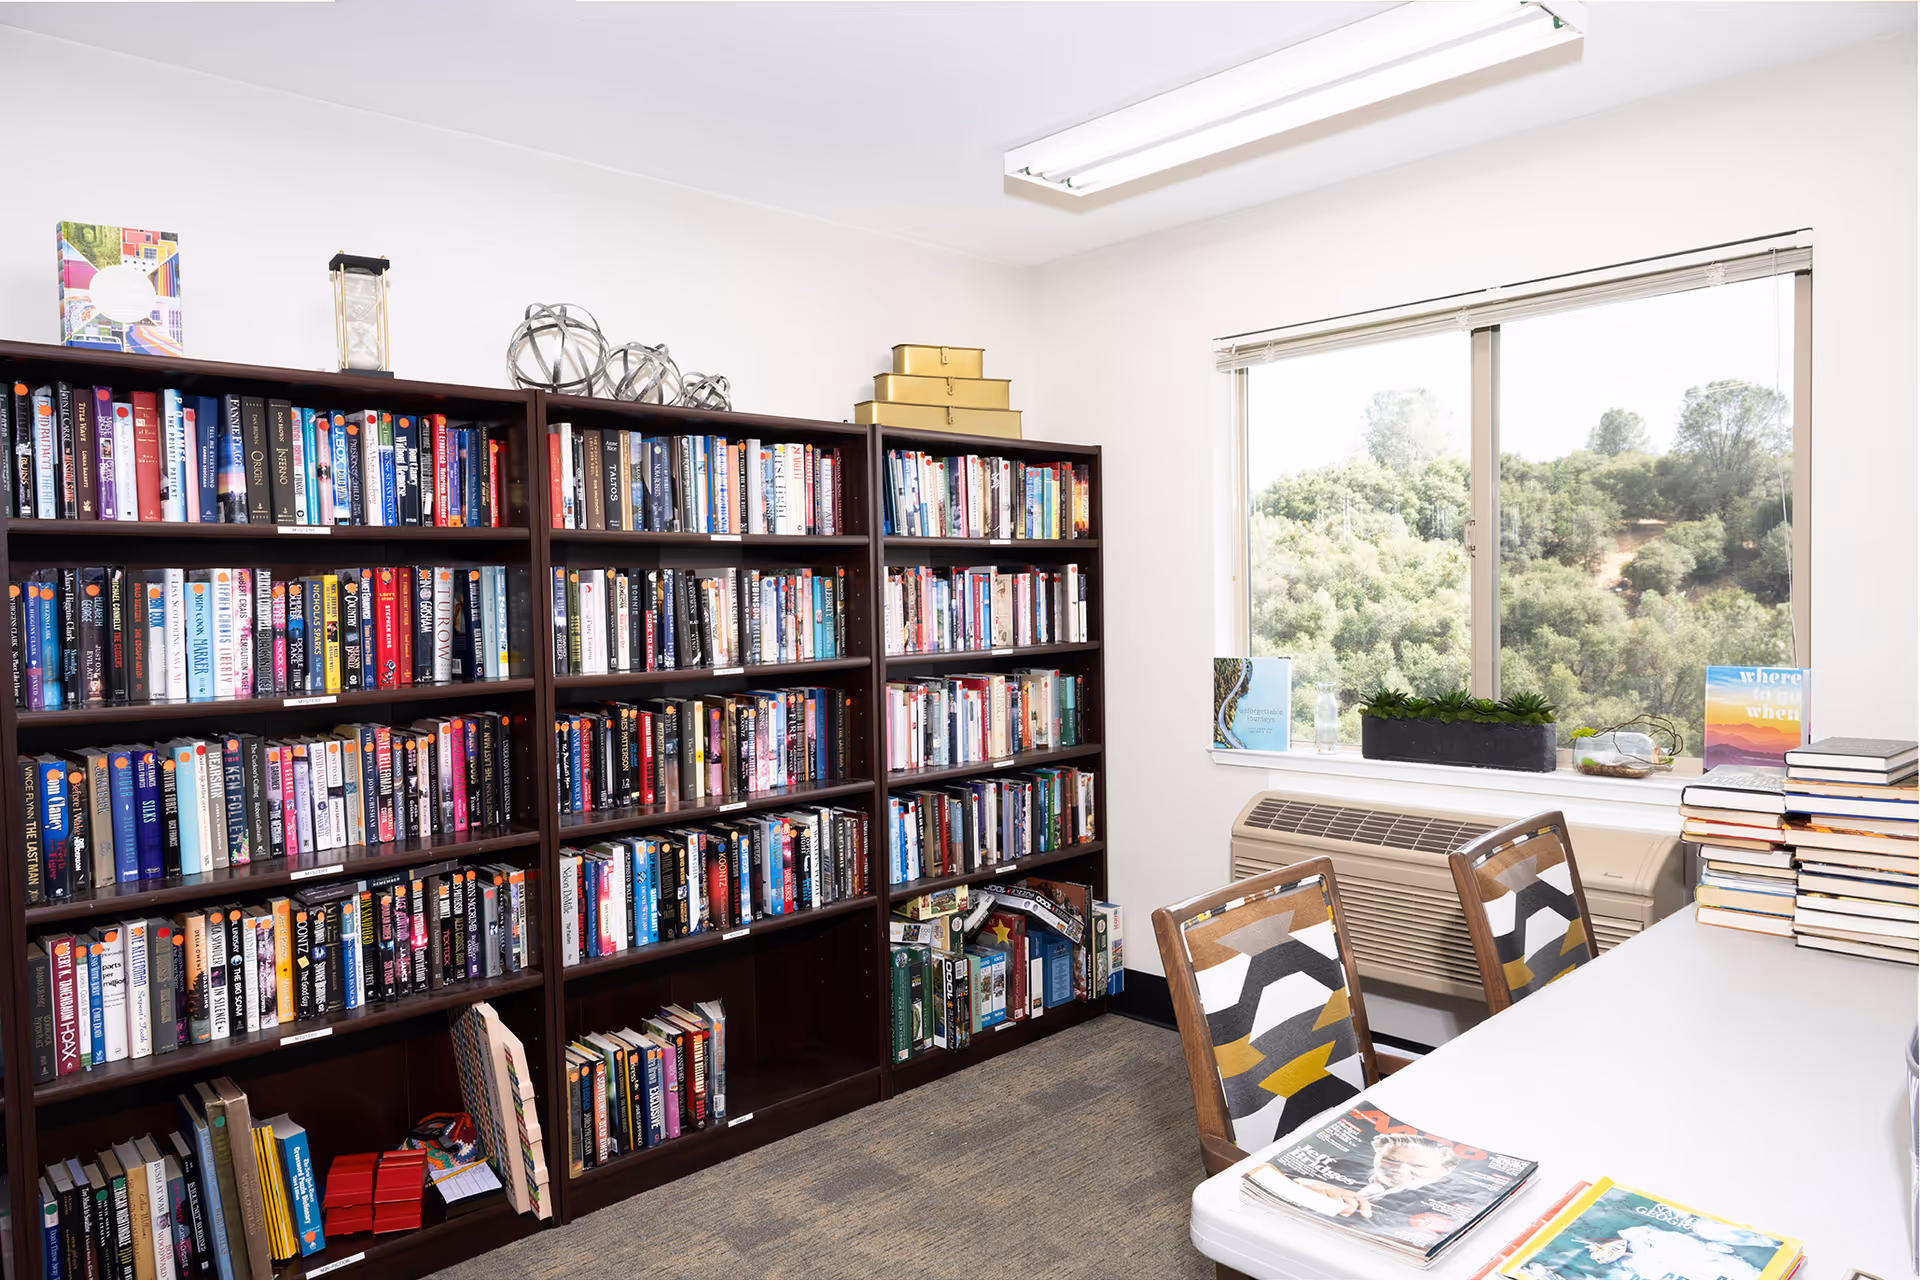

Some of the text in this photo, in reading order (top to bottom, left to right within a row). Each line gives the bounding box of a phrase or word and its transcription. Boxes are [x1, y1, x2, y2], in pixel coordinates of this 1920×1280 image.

[78, 402, 88, 442] TITLE WAVE
[230, 400, 243, 467] FANNIE FLAGG
[40, 429, 52, 470] BALDACCI
[168, 432, 177, 464] PRIVATE
[175, 427, 186, 462] JAMES
[336, 439, 346, 466] BOX
[63, 455, 74, 503] MISSION SONG
[170, 467, 178, 498] PATIENT
[251, 450, 264, 486] ORIGIN
[276, 448, 289, 485] INFERNO
[396, 436, 408, 497] Without Remorse
[407, 448, 418, 487] Tom Clancy
[608, 464, 618, 502] TALTOS
[62, 572, 75, 642] Mary Higgins Clark
[82, 600, 93, 622] GEORGE
[94, 596, 104, 627] ELIZABETH
[112, 602, 122, 631] CONNELLY
[150, 611, 164, 629] COOK
[312, 584, 322, 655] NICHOLAS SPARKS
[345, 595, 358, 627] COUNTRY
[420, 600, 432, 633] GRISHAM
[437, 587, 450, 662] TUROW
[648, 634, 653, 644] TO
[30, 636, 38, 656] CLARK
[114, 644, 122, 669] CLOSERS
[193, 612, 209, 676] COOK MARKER
[239, 598, 250, 692] CRAIS DEMOLITION ANGEL
[258, 632, 272, 660] BLACK
[290, 642, 298, 664] TAKE
[296, 638, 304, 668] DOUBLE
[220, 648, 232, 683] LIBERTY
[278, 668, 286, 683] OUT
[1740, 668, 1802, 684] where
[1753, 686, 1772, 701] to
[789, 713, 797, 741] FIRE
[1239, 707, 1284, 716] unforgettable
[1746, 704, 1801, 721] when
[250, 744, 258, 754] The
[584, 744, 592, 768] PERRY
[621, 732, 630, 772] PATTERSON
[208, 752, 224, 799] BEARSKIN
[270, 766, 281, 790] GARDNER
[379, 753, 393, 796] KELLERMAN
[470, 756, 479, 784] WOODS
[44, 796, 66, 831] Clancy
[142, 800, 156, 824] SILKS
[165, 794, 178, 815] FORCE
[225, 766, 244, 846] KEN FOLLETT
[368, 796, 377, 828] GRISHAM
[24, 766, 39, 885] VINCE FLYNN THE LAST MAN
[72, 812, 82, 836] Wake
[372, 877, 400, 887] REMEMBER
[718, 853, 727, 888] KOONTZ
[562, 866, 573, 914] Nelson DeMille
[1034, 895, 1052, 910] 1000
[454, 889, 464, 931] PATTERSON ALEX
[194, 930, 202, 948] DELIA
[232, 927, 240, 953] LINDSAY
[362, 910, 374, 945] SANDFORD
[432, 896, 442, 965] Warning Anonymous
[102, 962, 122, 971] parts
[103, 972, 114, 980] per
[400, 965, 408, 982] JANCE
[414, 946, 428, 982] Conviction
[946, 961, 954, 999] 1000
[212, 935, 226, 1026] SPINDLER IN SILENCE
[234, 983, 242, 995] BIG
[301, 981, 310, 1006] Good Guy
[59, 979, 77, 1062] TANENBAUM HOAX
[235, 996, 243, 1016] SCAM
[597, 1076, 608, 1160] SCOTTOLINE DEAD RINGER
[650, 1086, 660, 1130] EXCLUSIVE
[1289, 1147, 1356, 1185] Bridges
[1296, 1144, 1338, 1166] Jeff
[154, 1162, 167, 1214] BUSH AT WAR
[293, 1146, 312, 1224] Crossword Puzzle Dictionary
[158, 1232, 169, 1278] WOODWARD
[320, 1258, 350, 1272] NON-FICTION
